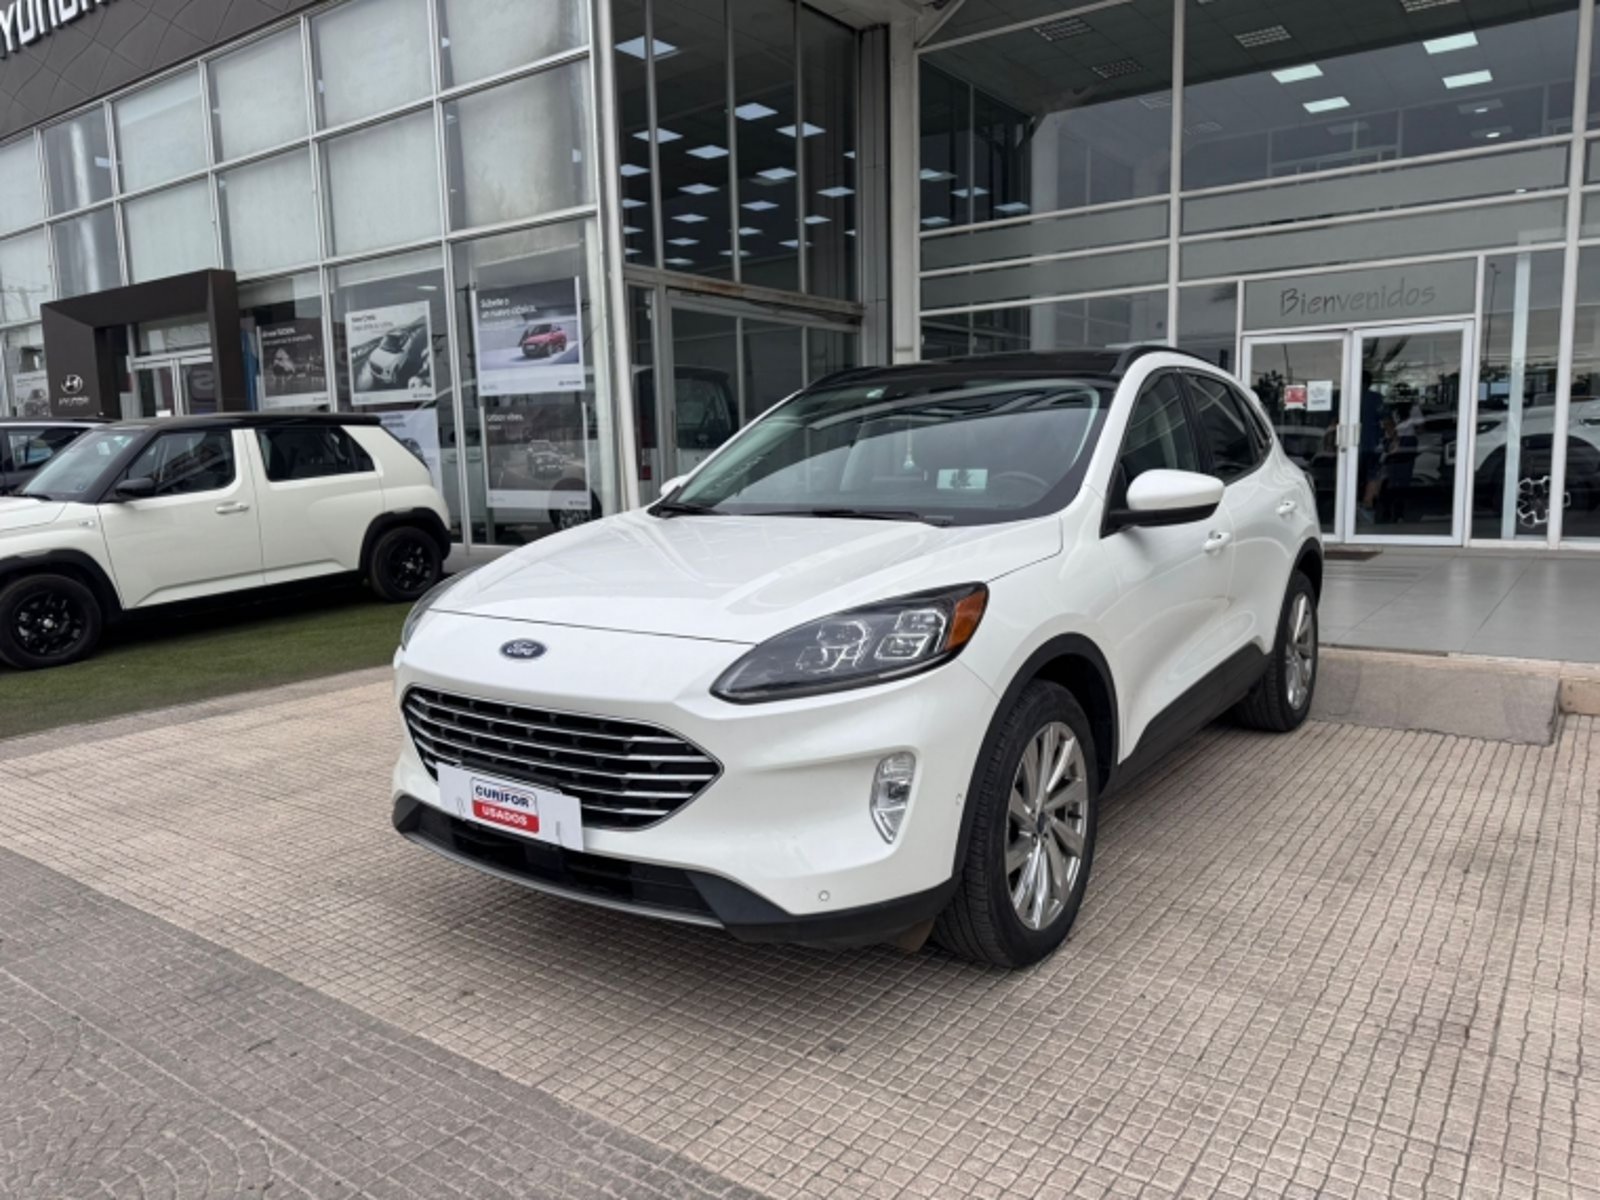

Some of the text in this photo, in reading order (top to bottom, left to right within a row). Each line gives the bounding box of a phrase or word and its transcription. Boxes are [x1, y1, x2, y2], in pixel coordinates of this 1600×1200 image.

[0, 0, 100, 52] YUND
[1279, 277, 1437, 317] Bienvenidos
[506, 641, 537, 656] Ford
[475, 784, 529, 808] CURIFOR
[481, 804, 528, 826] USADOS
